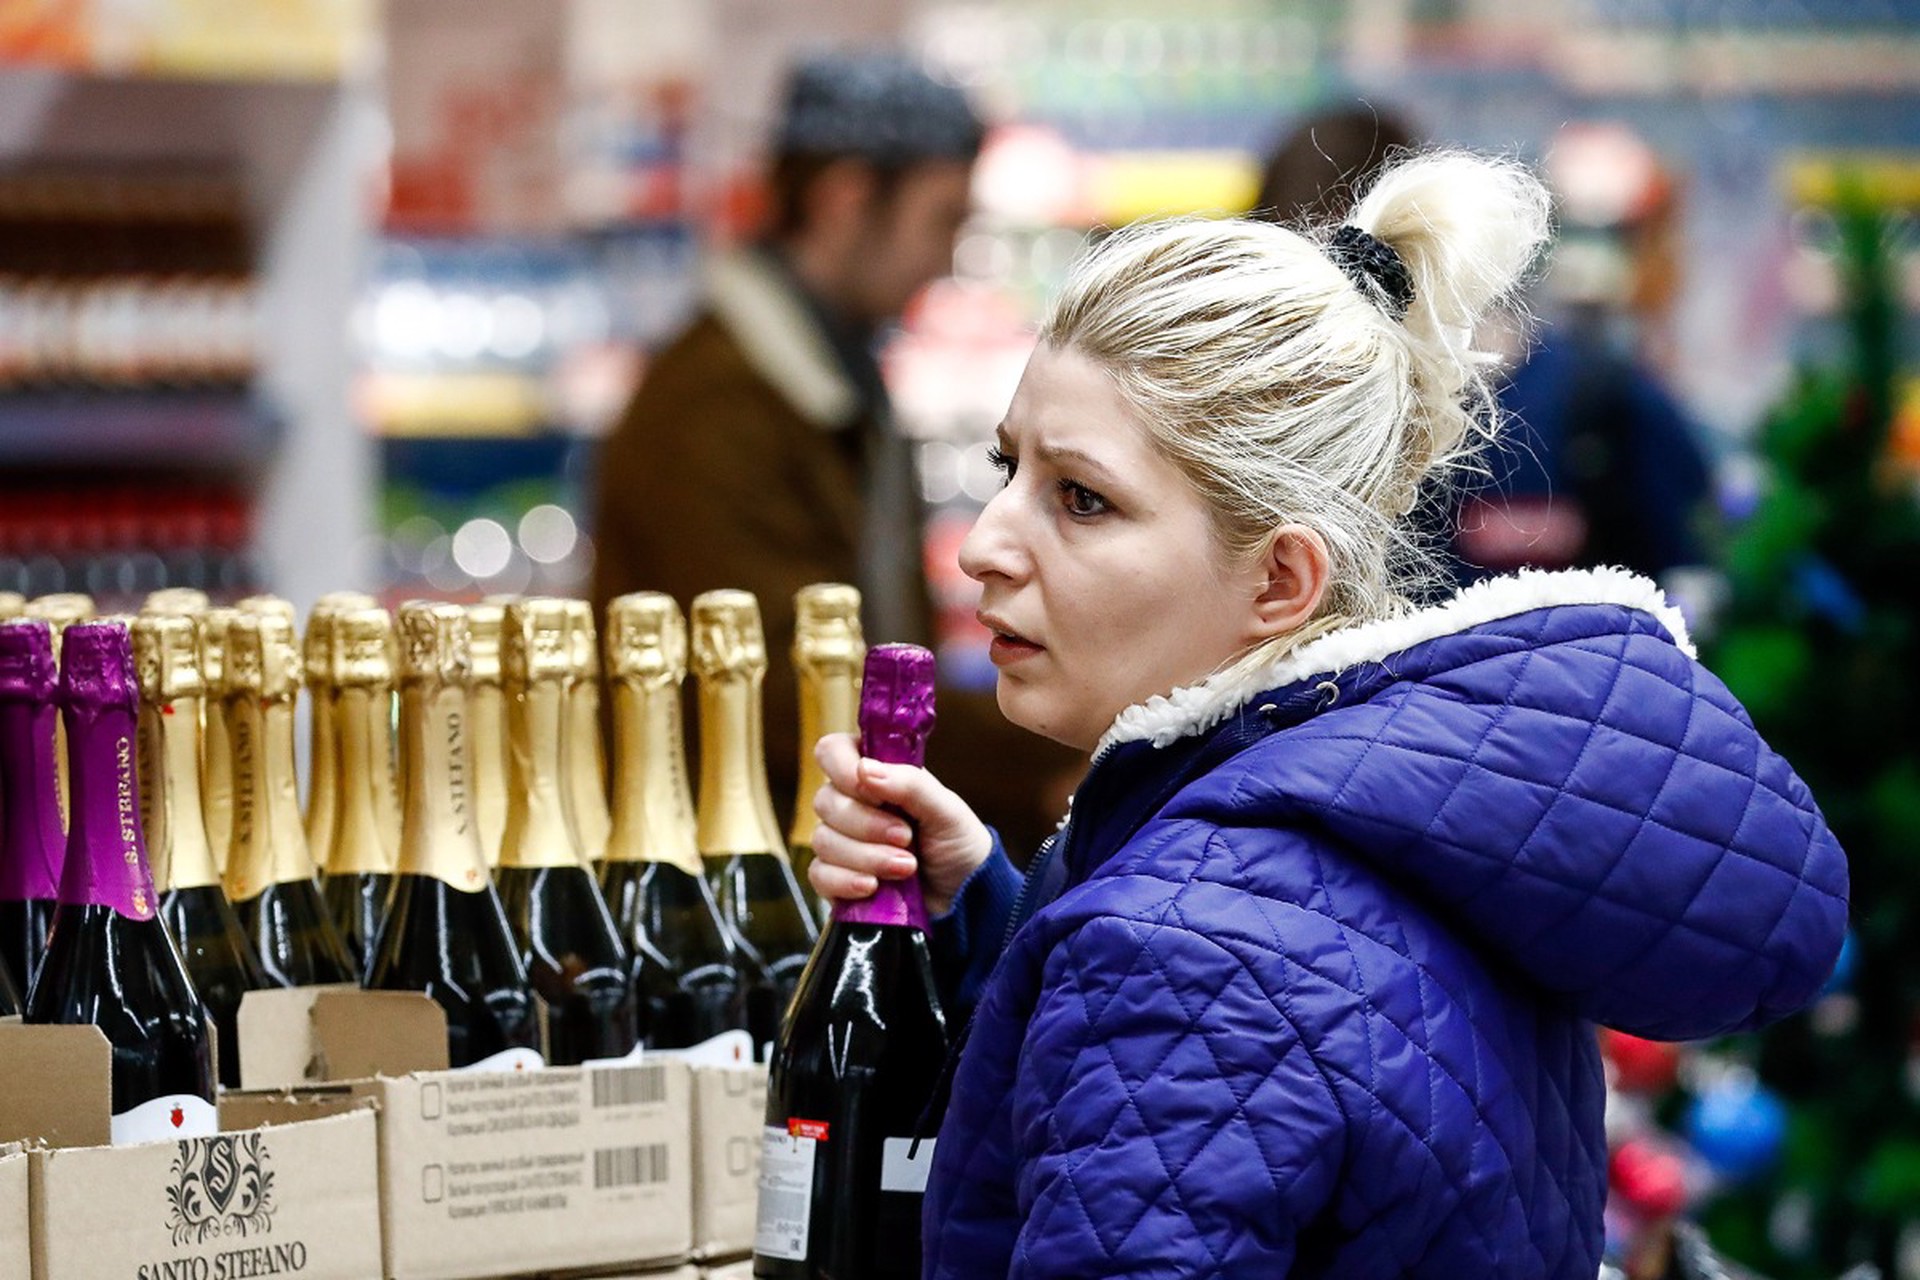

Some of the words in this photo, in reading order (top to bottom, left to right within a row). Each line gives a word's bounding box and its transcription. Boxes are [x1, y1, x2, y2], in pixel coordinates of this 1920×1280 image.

[115, 736, 136, 843] STEFANO
[138, 1256, 209, 1280] SANTO
[214, 1240, 308, 1280] STEFANO
